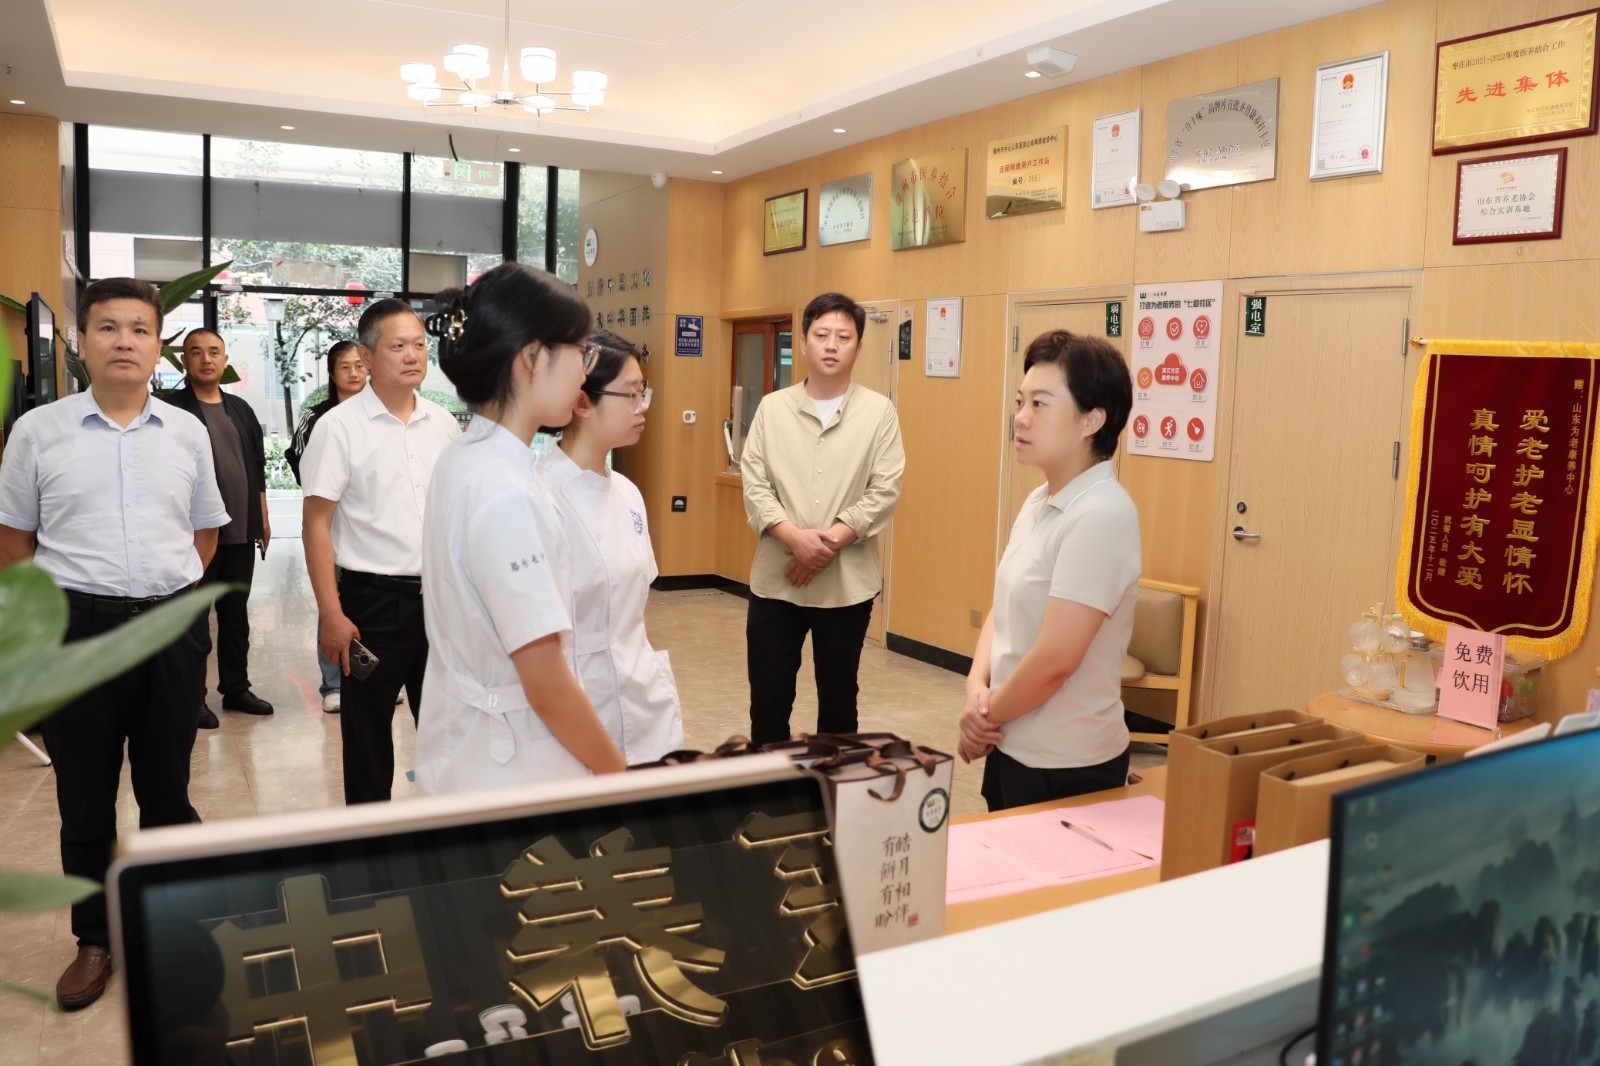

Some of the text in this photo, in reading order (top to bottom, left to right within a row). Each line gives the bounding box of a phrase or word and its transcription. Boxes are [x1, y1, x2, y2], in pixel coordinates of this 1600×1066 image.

[1455, 69, 1570, 104] 先进集体
[1477, 191, 1536, 206] 山东省养老协会
[1480, 204, 1532, 217] 综合实训基地
[1110, 304, 1120, 335] 弱电室
[1250, 299, 1263, 334] 强电室
[1454, 408, 1500, 591] 真情呵护有大爱
[1502, 409, 1550, 596] 爱老护老显情怀
[1454, 640, 1494, 667] 免费
[1451, 668, 1490, 695] 饮用
